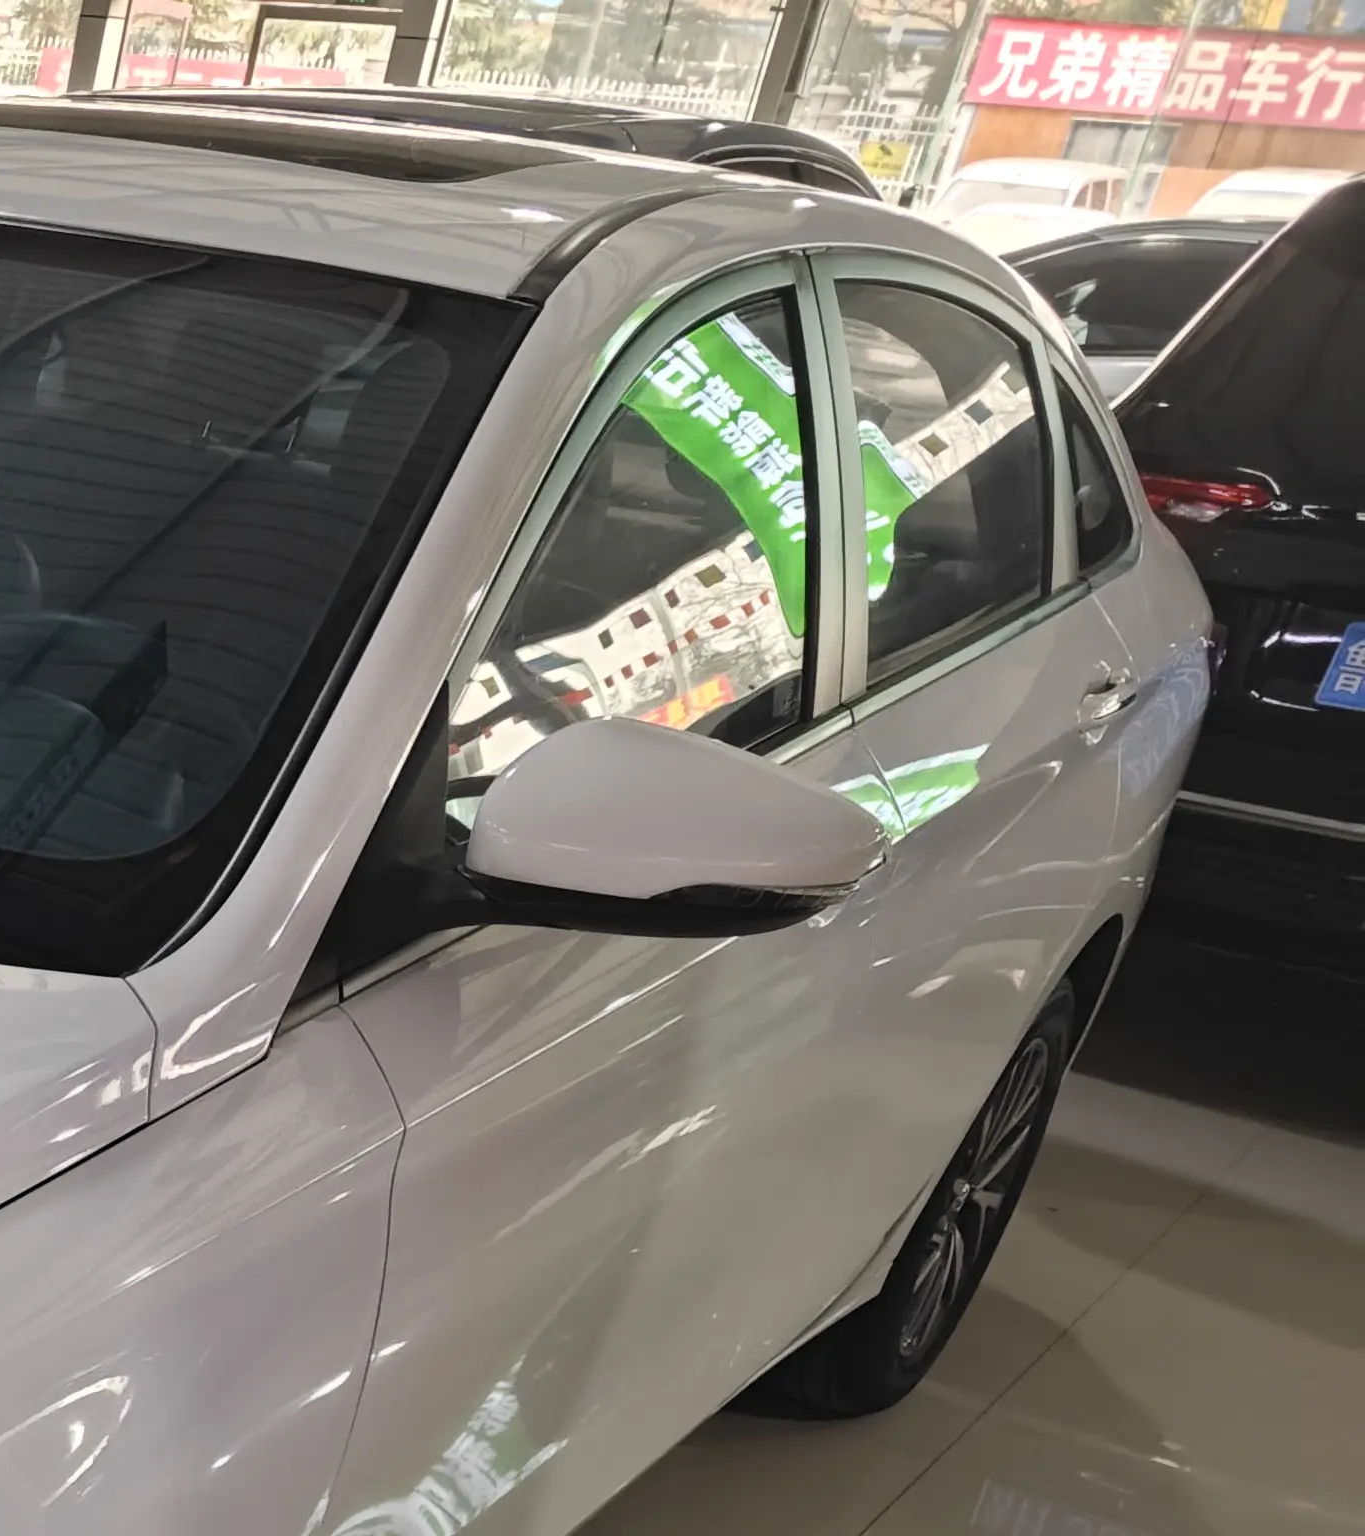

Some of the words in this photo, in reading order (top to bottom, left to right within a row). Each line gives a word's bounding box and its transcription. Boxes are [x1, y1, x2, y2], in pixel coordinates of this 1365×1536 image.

[980, 29, 1365, 121] 兄弟精品车行
